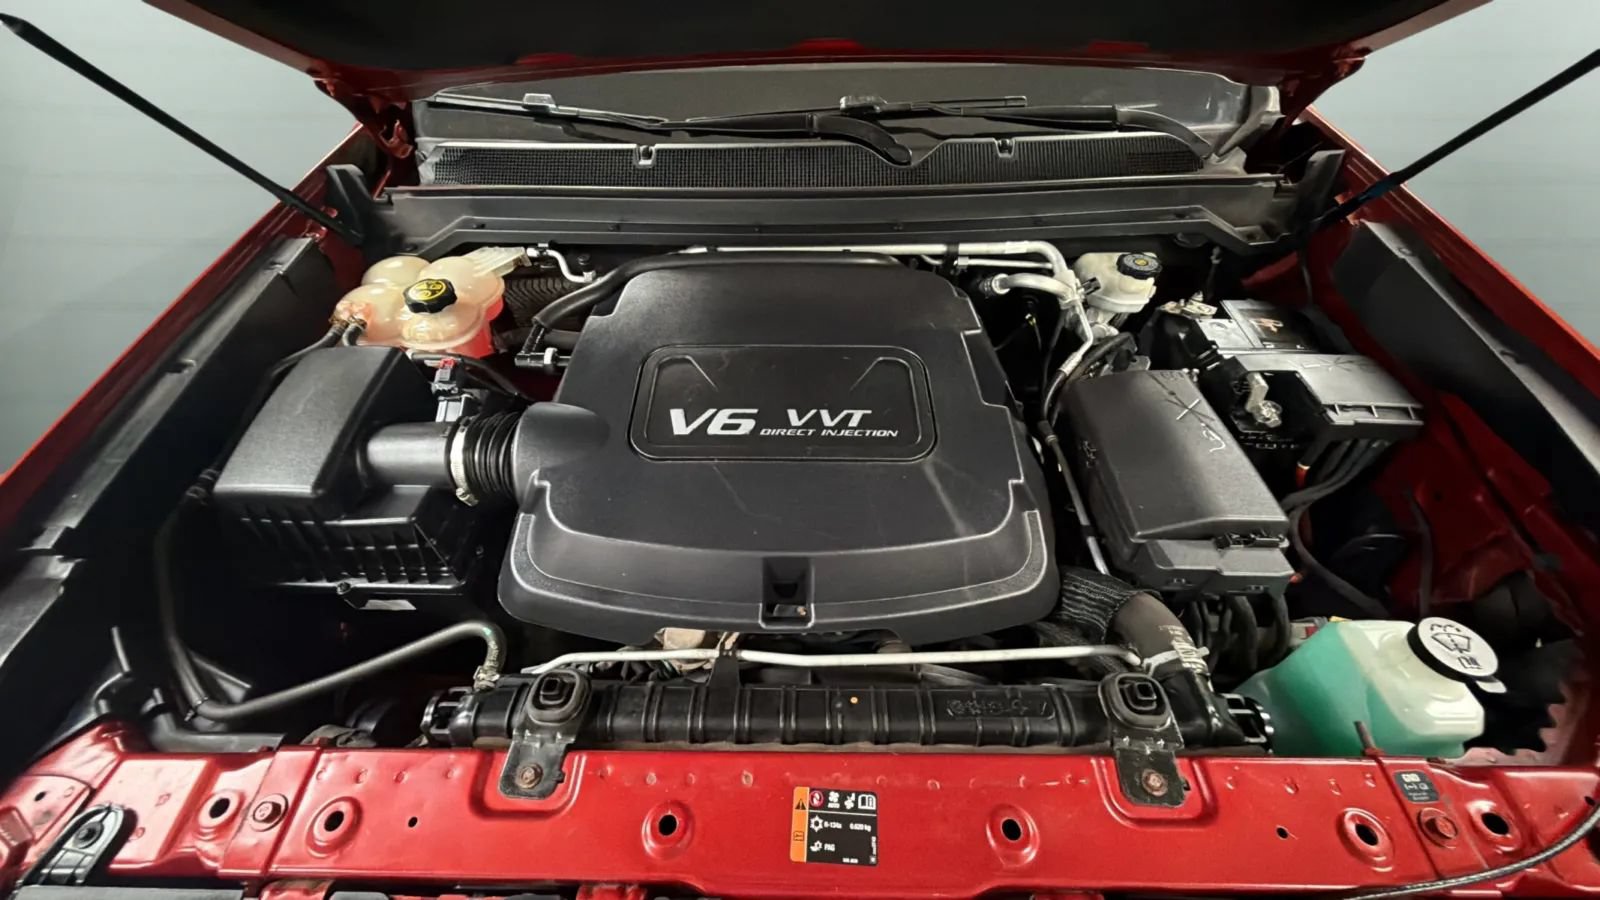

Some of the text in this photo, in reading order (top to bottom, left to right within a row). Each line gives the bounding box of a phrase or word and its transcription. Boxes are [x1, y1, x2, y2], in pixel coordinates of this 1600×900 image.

[669, 408, 873, 436] V6 VVT
[759, 428, 899, 438] DIRECT INJECTION
